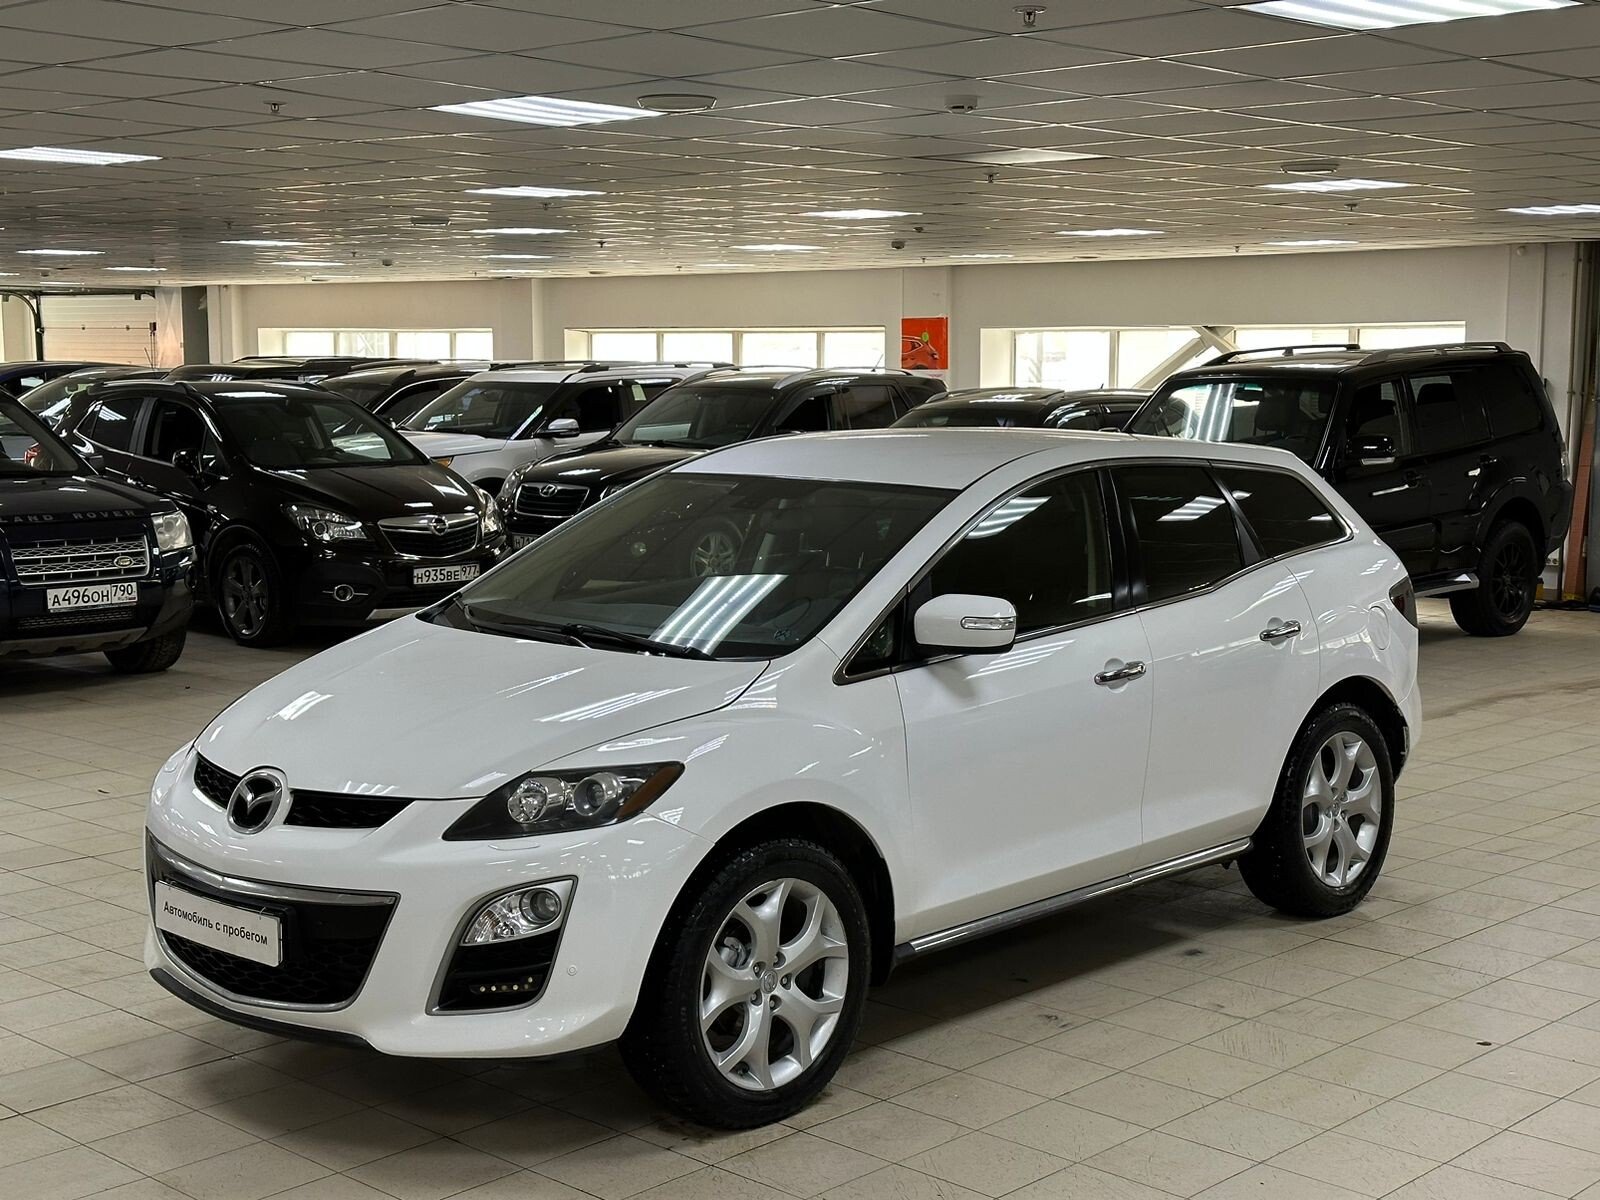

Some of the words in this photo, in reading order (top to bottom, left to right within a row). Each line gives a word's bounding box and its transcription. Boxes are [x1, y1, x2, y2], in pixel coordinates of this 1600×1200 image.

[72, 509, 135, 519] ROVER
[461, 565, 477, 576] 977
[52, 588, 110, 606] А496ОН
[112, 584, 133, 597] 790
[163, 901, 213, 929] Автомобиль
[215, 921, 221, 931] с
[223, 924, 268, 945] пробегом
